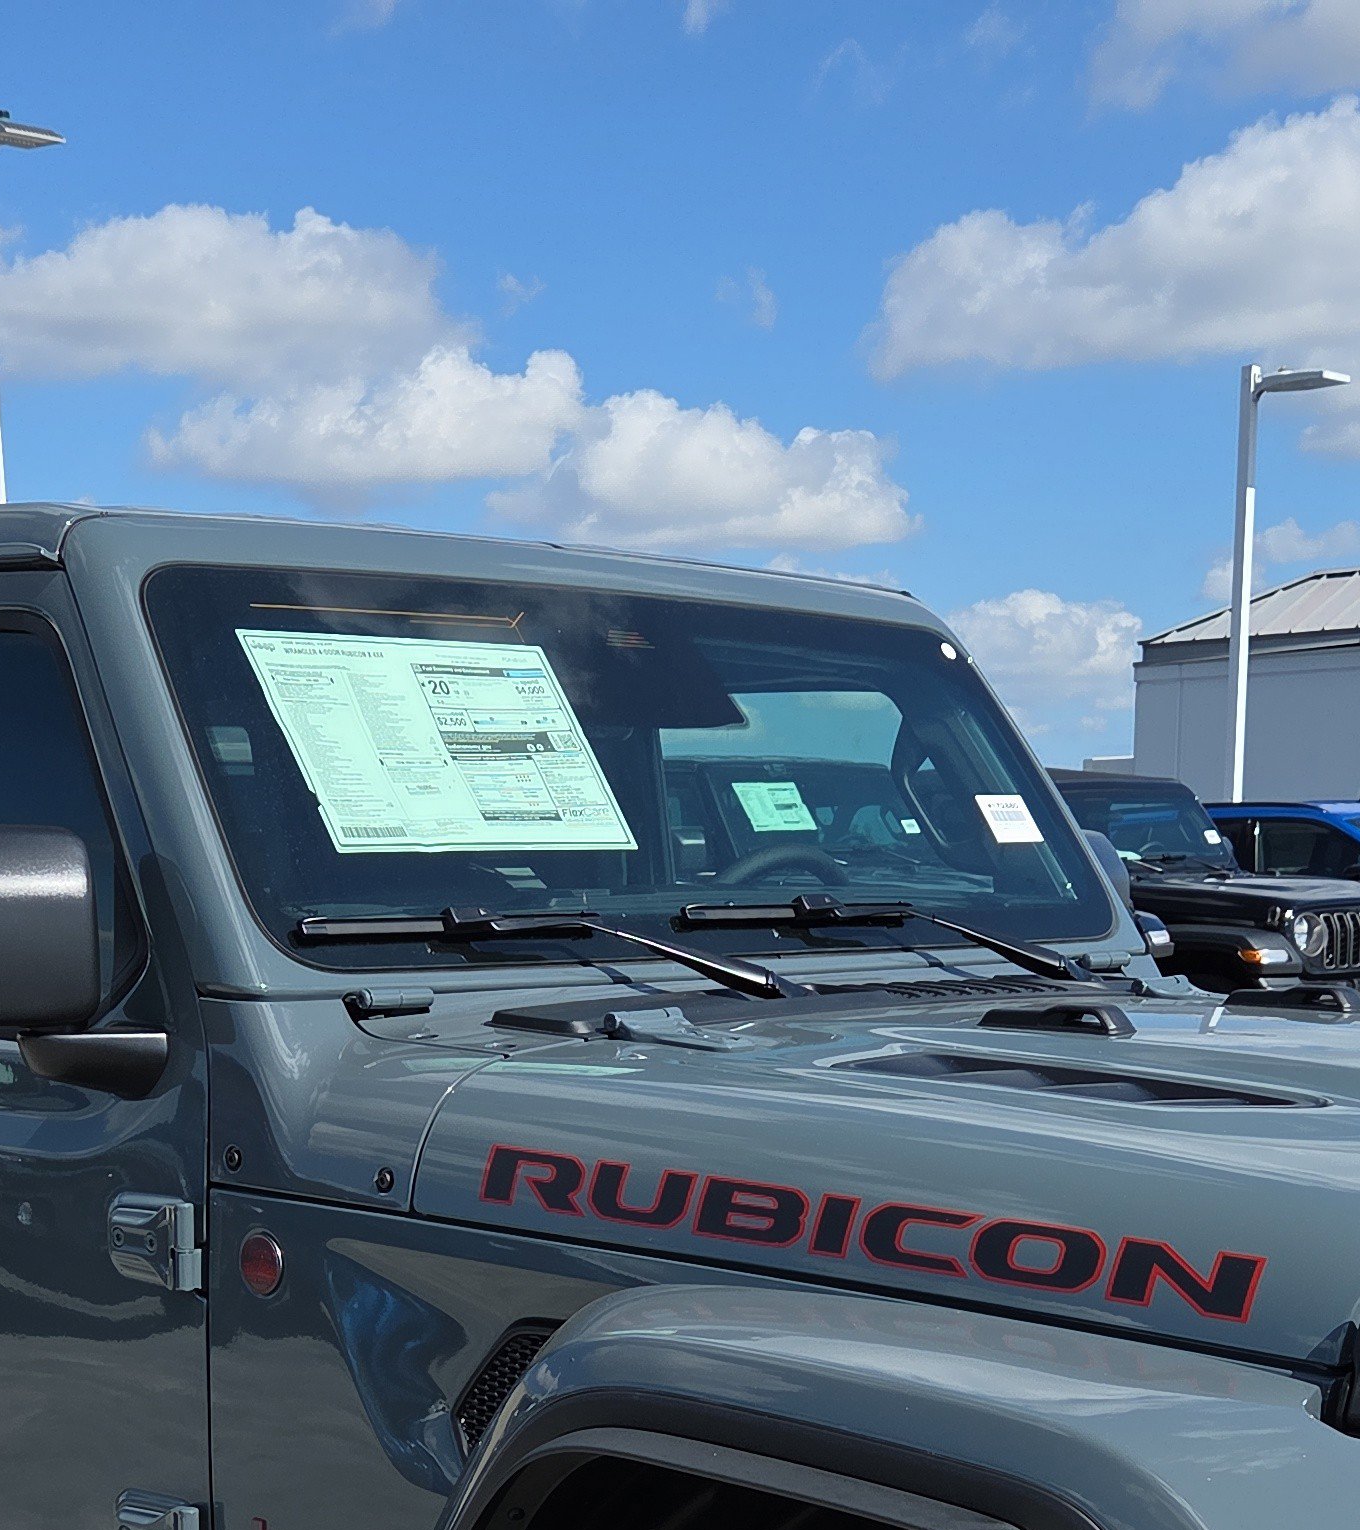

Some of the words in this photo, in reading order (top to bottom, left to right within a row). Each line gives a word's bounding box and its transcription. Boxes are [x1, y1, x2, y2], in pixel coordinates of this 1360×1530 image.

[251, 640, 275, 652] Jeep
[284, 647, 317, 656] WRANGLER
[428, 680, 450, 695] 20
[515, 685, 545, 695] $4,000
[437, 716, 467, 727] $2,500
[480, 1143, 1267, 1324] RUBICON
